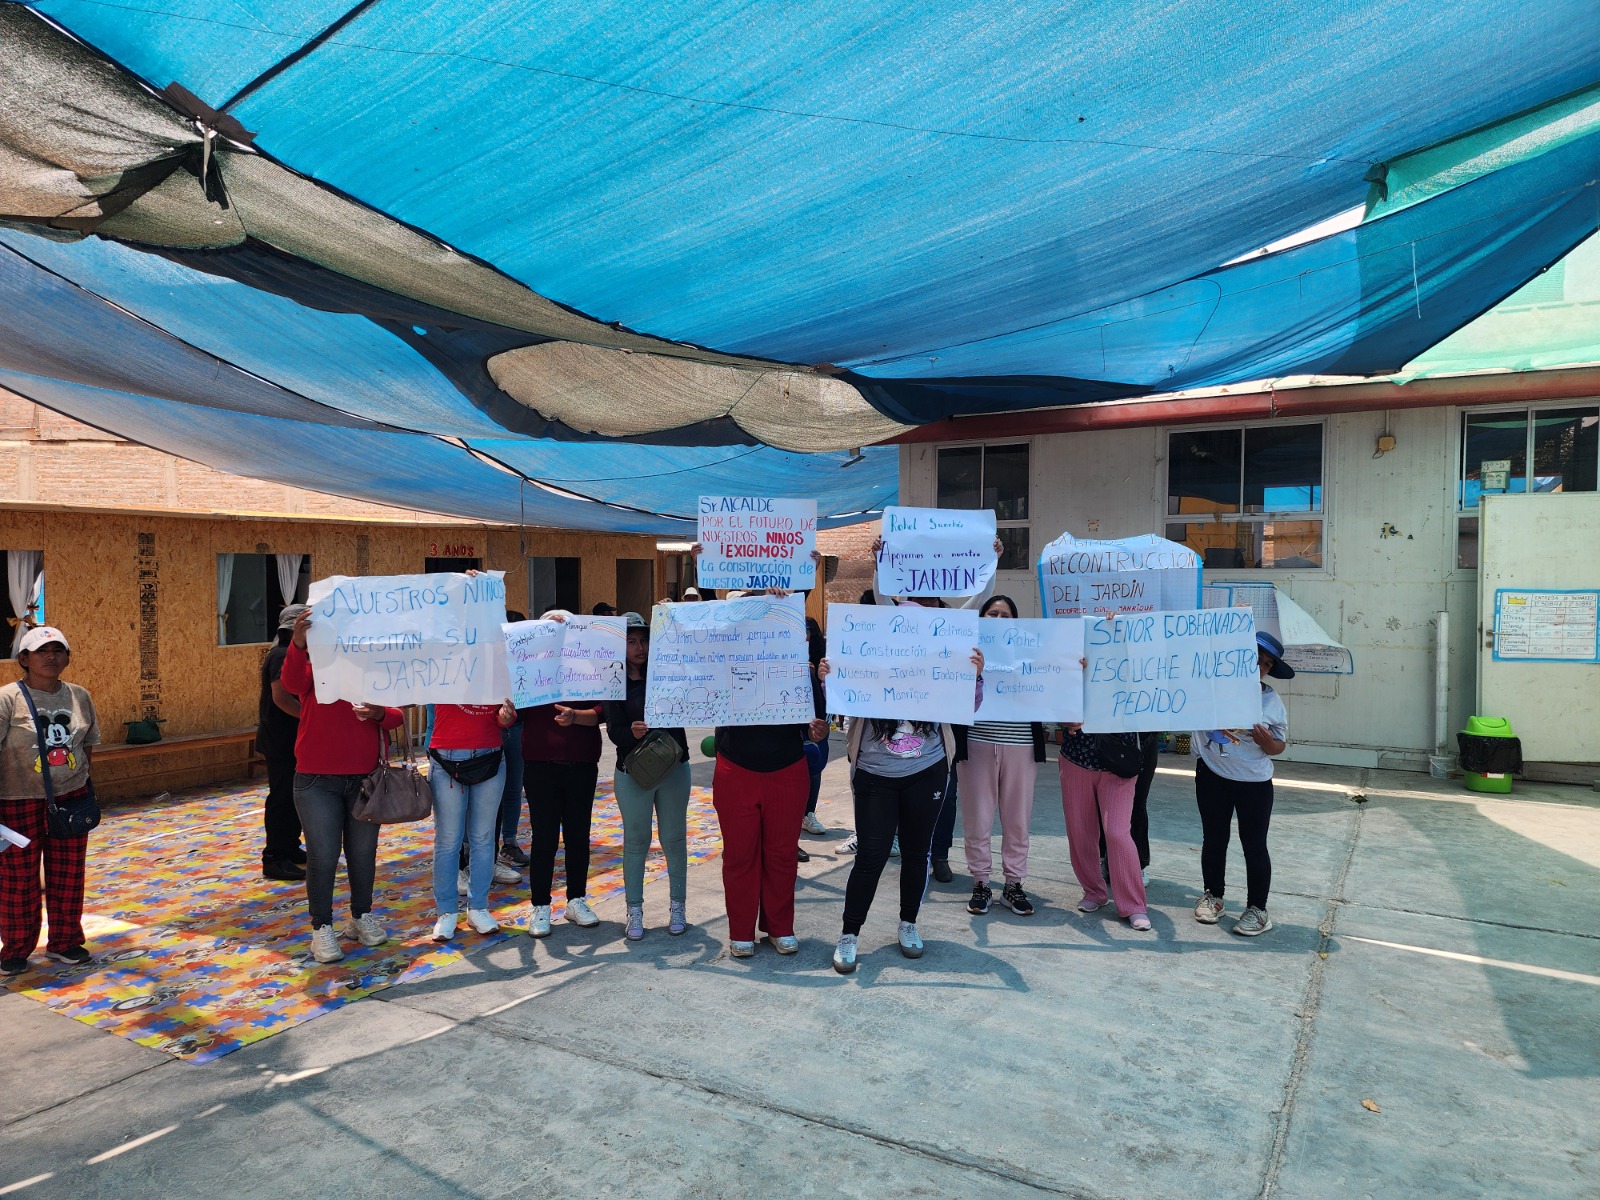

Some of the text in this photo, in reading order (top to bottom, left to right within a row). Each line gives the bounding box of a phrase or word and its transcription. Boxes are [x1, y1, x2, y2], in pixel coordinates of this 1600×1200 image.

[720, 497, 774, 512] ALCALDE
[702, 515, 816, 531] POR EL FUTURO DE
[702, 531, 758, 543] NUESTROS
[430, 543, 438, 557] 3
[951, 549, 981, 558] nuestro
[798, 562, 814, 575] de
[904, 566, 976, 592] JARDÍN
[322, 583, 449, 618] NUESTROS
[1052, 585, 1080, 603] DEL
[841, 613, 877, 633] Señor
[929, 617, 973, 637] Pedimos
[334, 628, 477, 654] NECESITAN SU
[841, 640, 852, 655] La
[938, 645, 952, 658] de
[372, 651, 478, 691] JARDÍN
[837, 667, 879, 679] Nuestro
[1022, 661, 1061, 676] Nuestro
[1090, 654, 1181, 683] ESCUCHE
[996, 680, 1045, 694] Construido
[1112, 687, 1187, 717] PEDIDO
